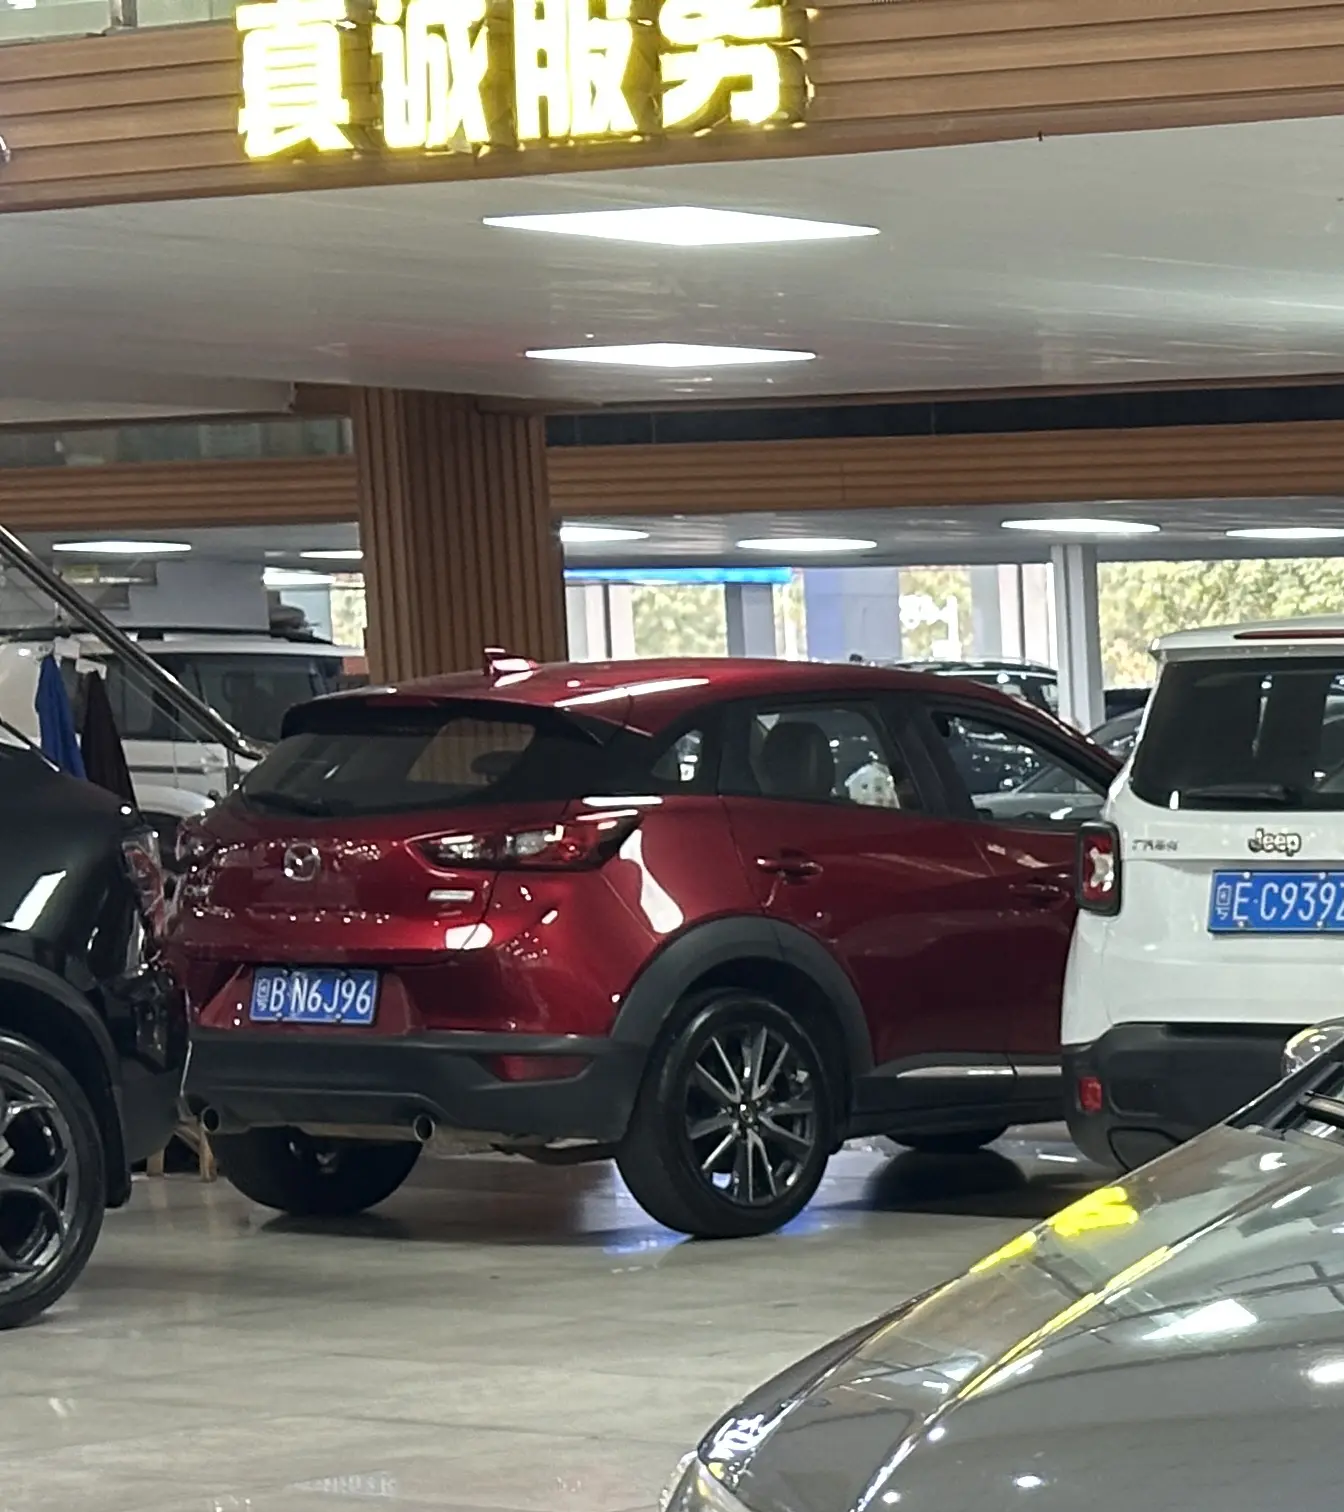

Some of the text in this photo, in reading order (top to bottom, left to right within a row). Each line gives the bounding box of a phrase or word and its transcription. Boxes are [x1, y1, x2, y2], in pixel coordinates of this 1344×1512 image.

[236, 0, 786, 158] 真诚服务
[1247, 827, 1302, 857] Jeep
